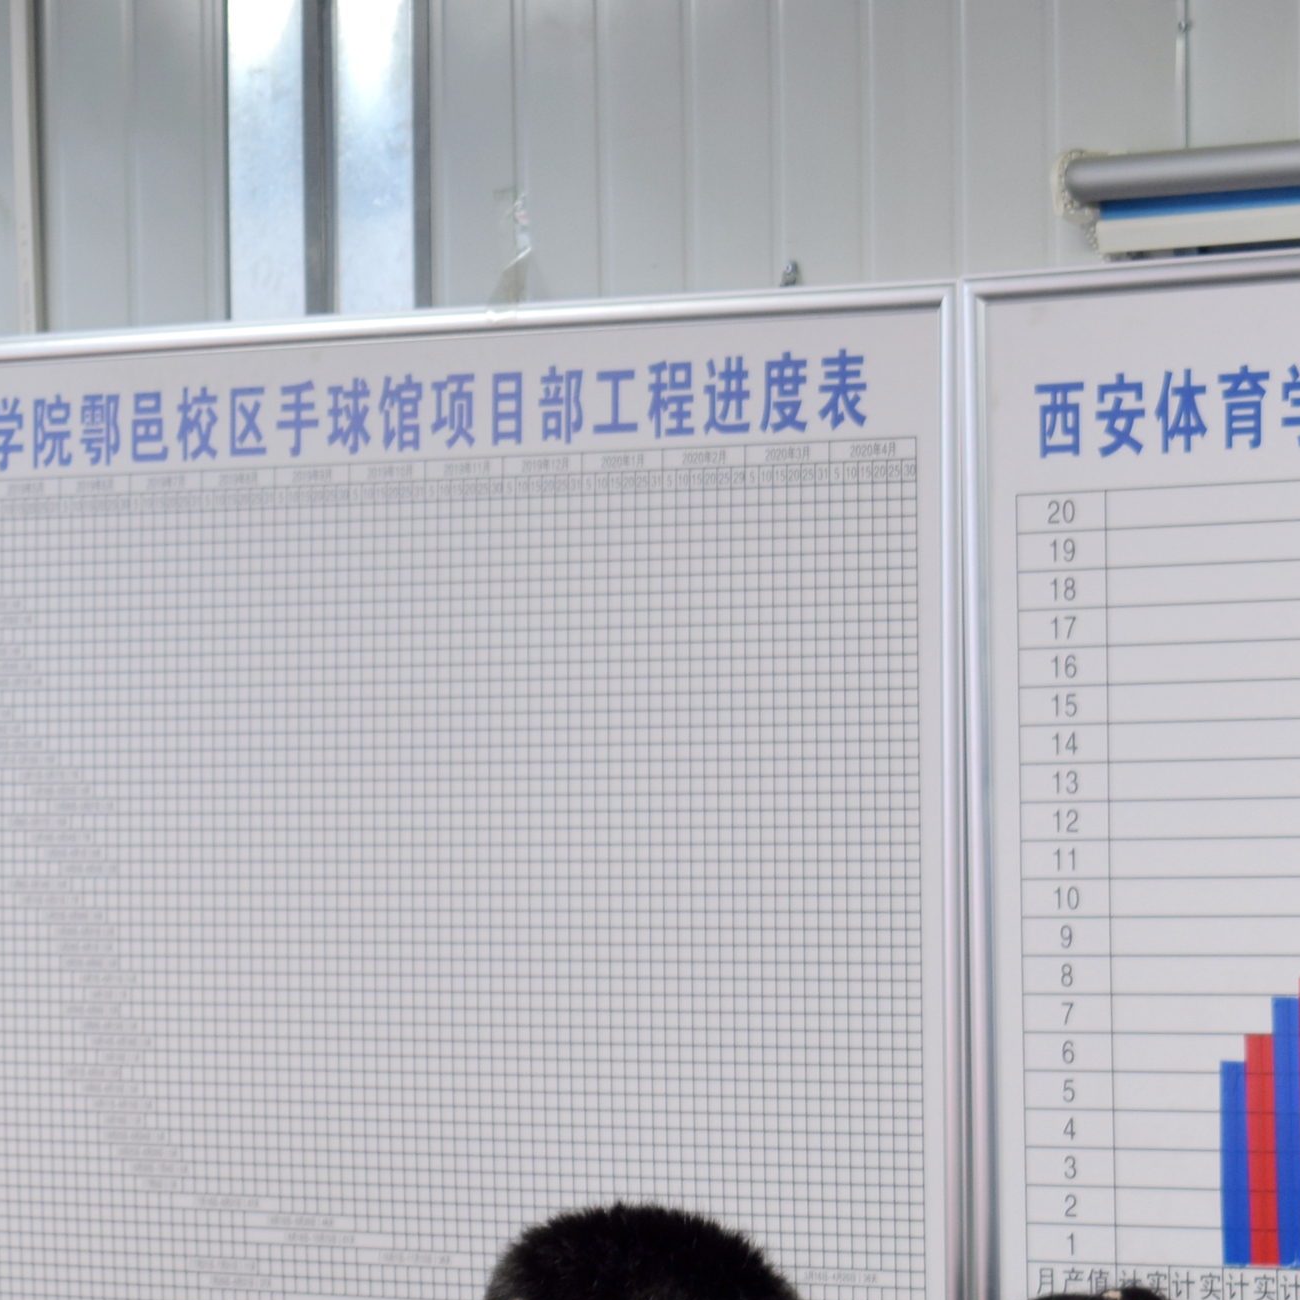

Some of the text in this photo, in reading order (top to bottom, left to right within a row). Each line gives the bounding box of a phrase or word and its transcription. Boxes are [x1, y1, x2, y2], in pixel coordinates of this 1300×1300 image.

[601, 454, 644, 469] 2020年1月
[682, 450, 726, 465] 2020年2月
[765, 446, 810, 462] 2020年3月
[850, 442, 896, 457] 2020年4月
[666, 475, 672, 488] 5
[679, 474, 689, 487] 10
[692, 473, 703, 486] 15
[704, 473, 716, 485] 20
[718, 472, 729, 485] 25
[733, 471, 744, 484] 29
[749, 471, 755, 483] 5
[762, 470, 772, 483] 10
[775, 469, 786, 482] 15
[788, 468, 800, 482] 20
[802, 468, 814, 481] 25
[816, 467, 827, 480] 31
[834, 466, 840, 479] 5
[847, 466, 857, 479] 10
[860, 465, 871, 478] 15
[873, 464, 885, 477] 20
[888, 464, 900, 477] 25
[904, 463, 915, 476] 30
[1047, 499, 1076, 524] 20
[1049, 538, 1077, 563] 19
[1049, 577, 1077, 602] 18
[1050, 615, 1077, 640] 17
[1051, 654, 1077, 679] 16
[1051, 693, 1078, 718] 15
[1051, 731, 1079, 756] 14
[1051, 771, 1079, 795] 13
[1052, 810, 1079, 834] 12
[1052, 849, 1078, 872] 11
[1053, 887, 1080, 911] 10
[1060, 925, 1073, 949] 9
[1060, 964, 1074, 988] 8
[1061, 1003, 1075, 1026] 7
[1062, 1041, 1075, 1064] 6
[1062, 1079, 1076, 1104] 5
[1063, 1118, 1076, 1141] 4
[1063, 1156, 1078, 1180] 3
[1064, 1195, 1078, 1218] 2
[1067, 1233, 1075, 1256] 1
[1037, 1267, 1110, 1295] 月产值
